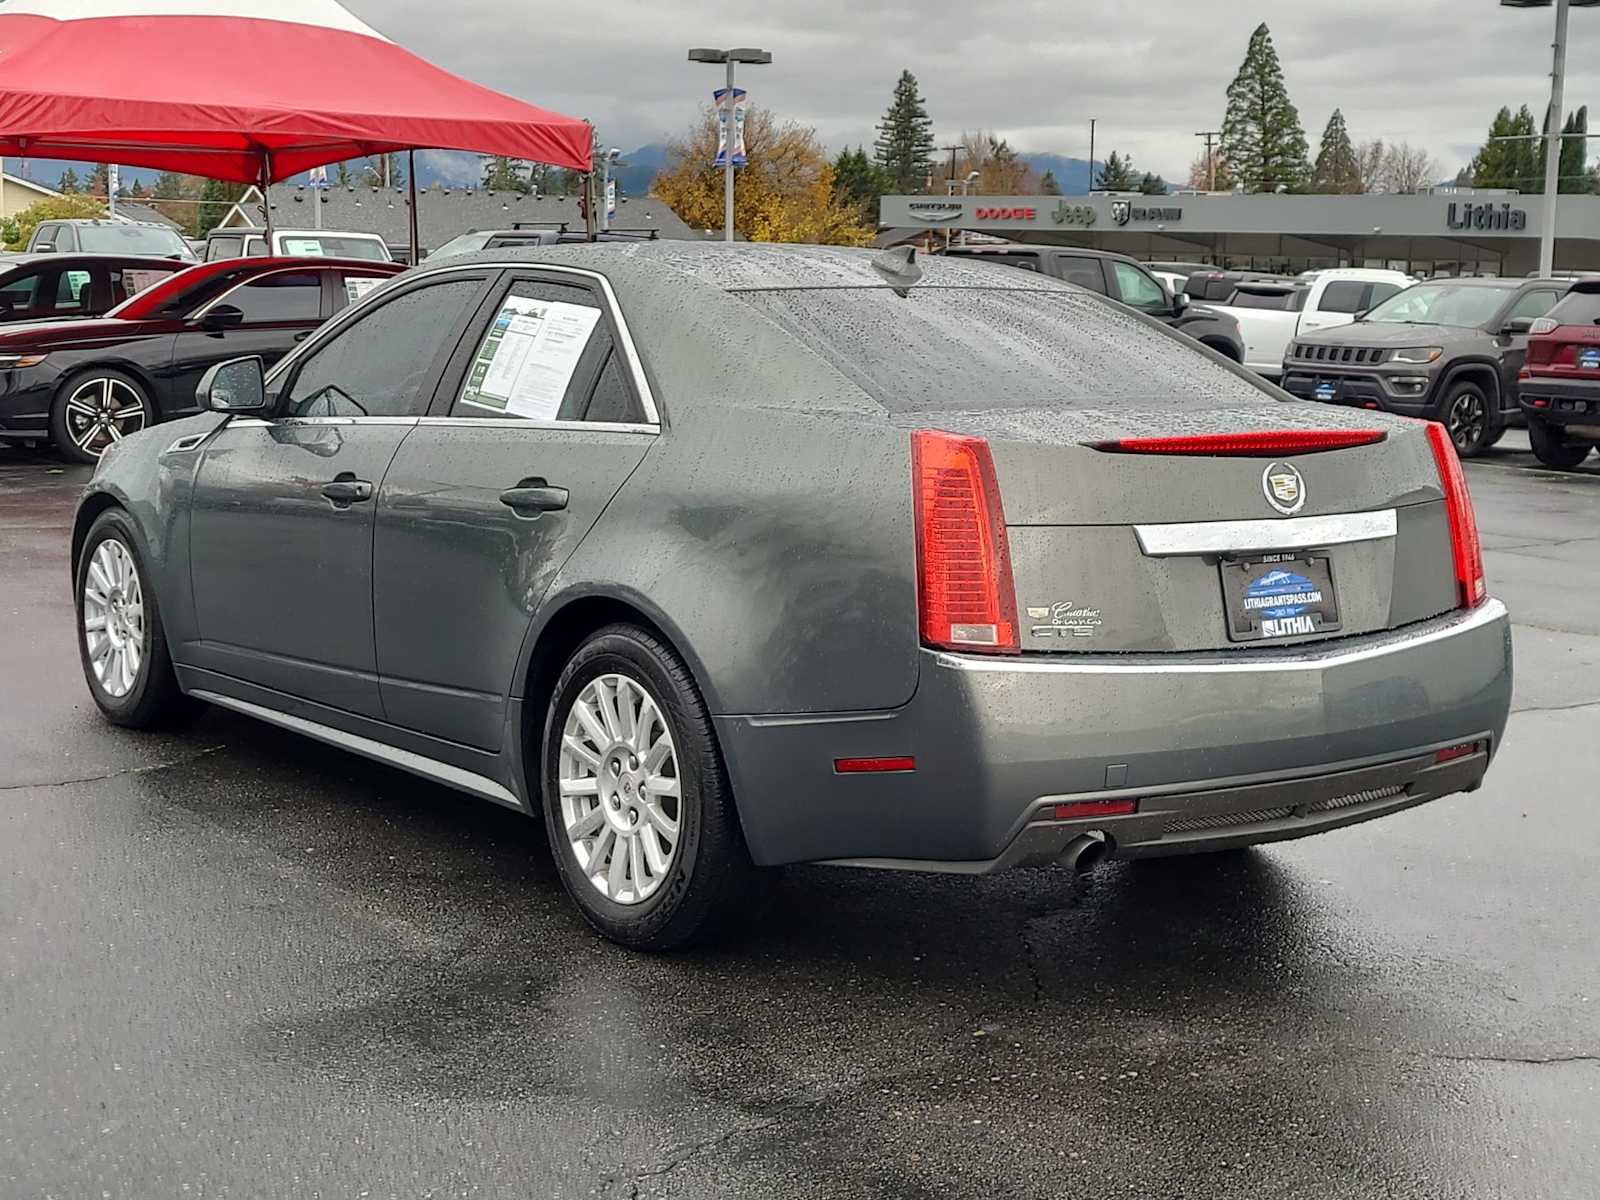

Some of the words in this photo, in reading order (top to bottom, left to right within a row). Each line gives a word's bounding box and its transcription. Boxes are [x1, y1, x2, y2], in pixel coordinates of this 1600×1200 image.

[975, 207, 1036, 220] DODGE
[1052, 200, 1097, 228] Jeep
[1446, 202, 1527, 231] Lithia
[1274, 616, 1315, 635] LITHIA
